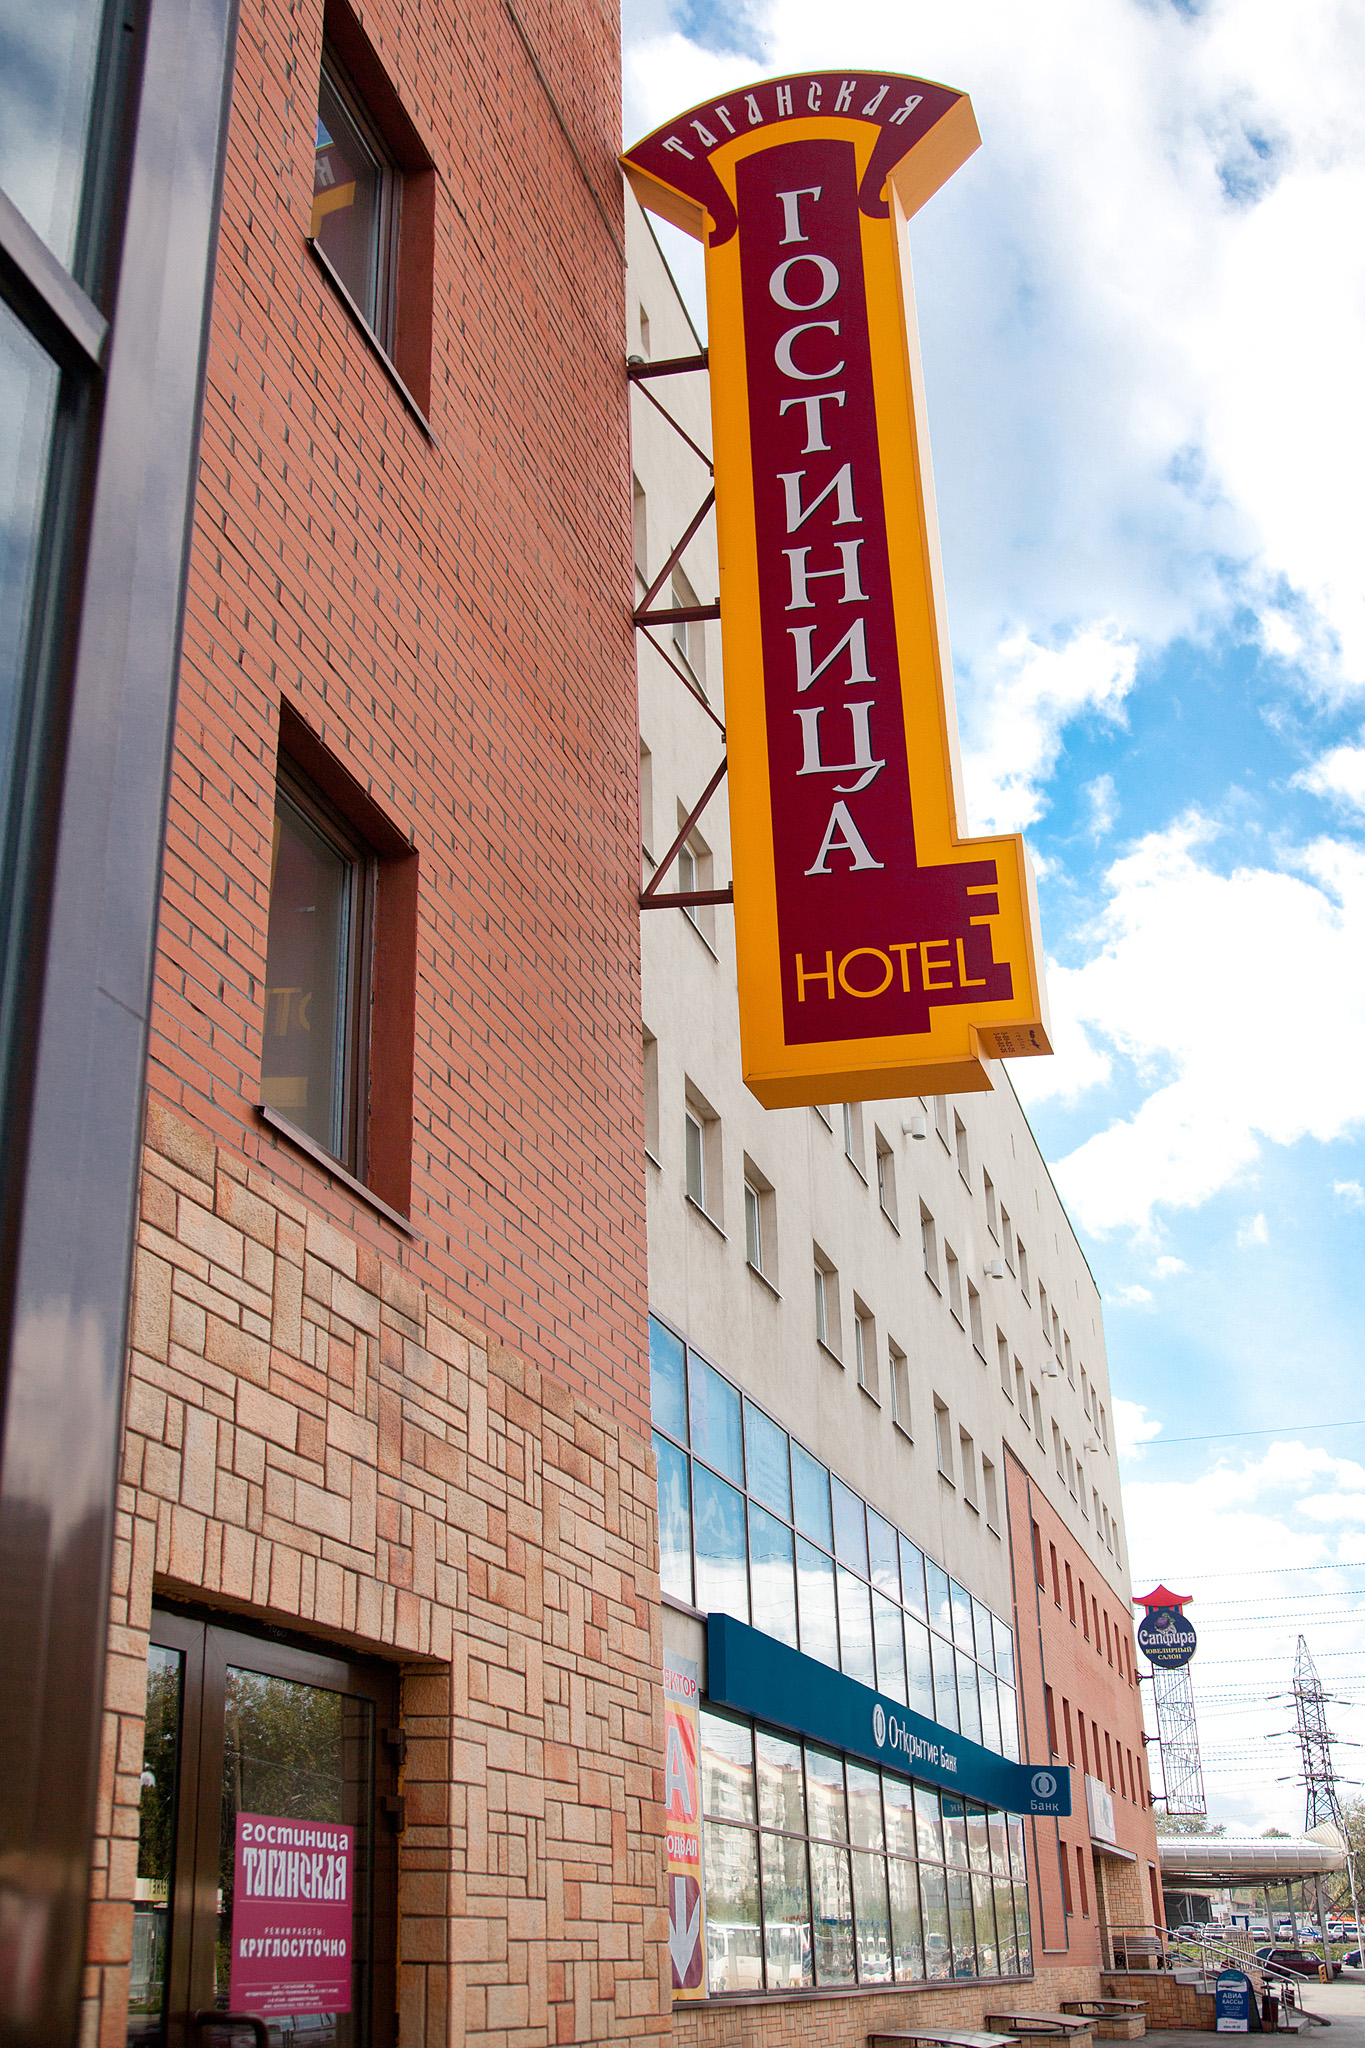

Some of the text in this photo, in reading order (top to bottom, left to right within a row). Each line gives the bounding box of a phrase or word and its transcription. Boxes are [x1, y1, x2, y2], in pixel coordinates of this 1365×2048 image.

[768, 185, 887, 877] ГОСТИНИЦА
[795, 937, 987, 1003] HOTEL
[1140, 1629, 1196, 1648] Сапфира
[1145, 1646, 1193, 1655] ЮВЕЛИРНЫЙ
[888, 1715, 957, 1774] Открытие Банк
[1030, 1799, 1060, 1812] Банк
[241, 1822, 349, 1852] гостиница
[242, 1846, 347, 1901] ТАГАНСКАЯ
[239, 1938, 347, 1958] КРУГЛОСУТОЧНО
